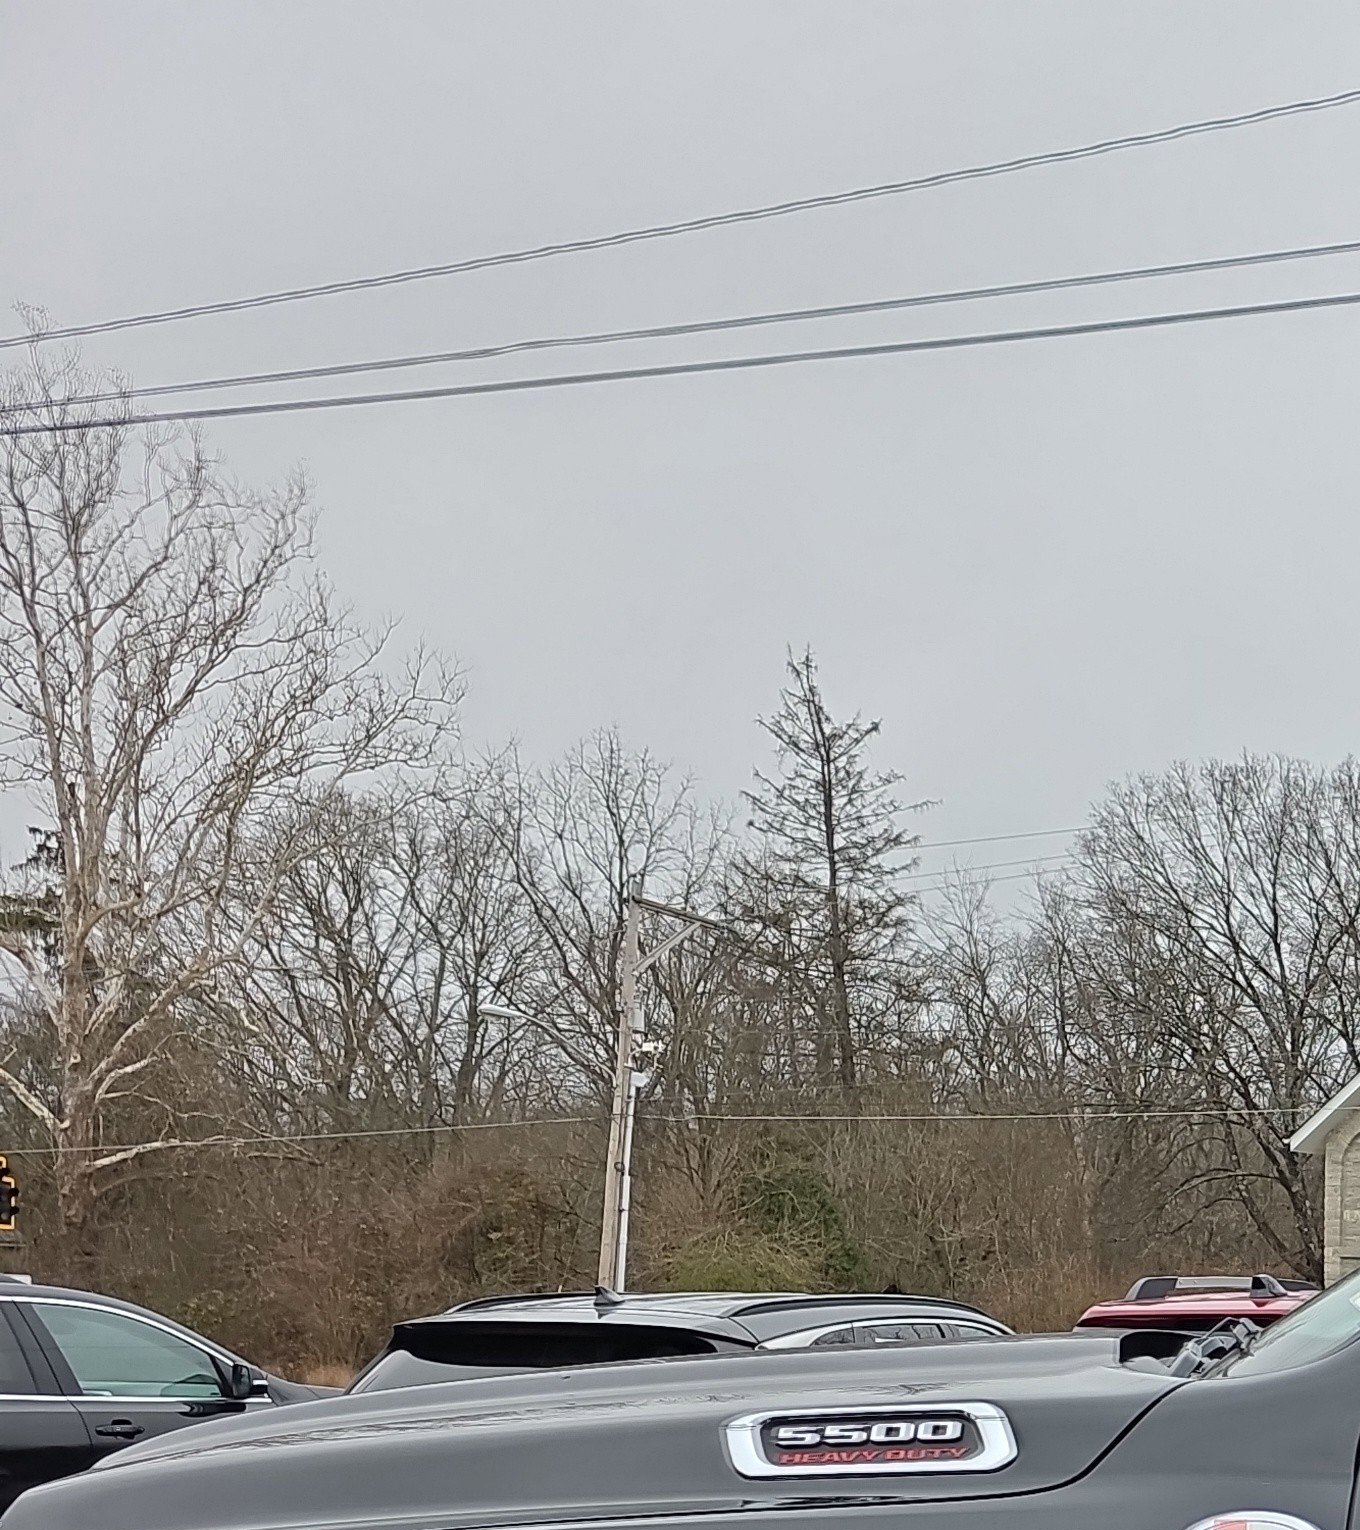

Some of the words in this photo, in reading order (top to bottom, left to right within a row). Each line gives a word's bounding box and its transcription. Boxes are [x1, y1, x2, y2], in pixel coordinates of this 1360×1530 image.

[776, 1421, 963, 1447] 5500
[779, 1449, 882, 1465] HEAVY
[884, 1447, 969, 1461] DUTY
